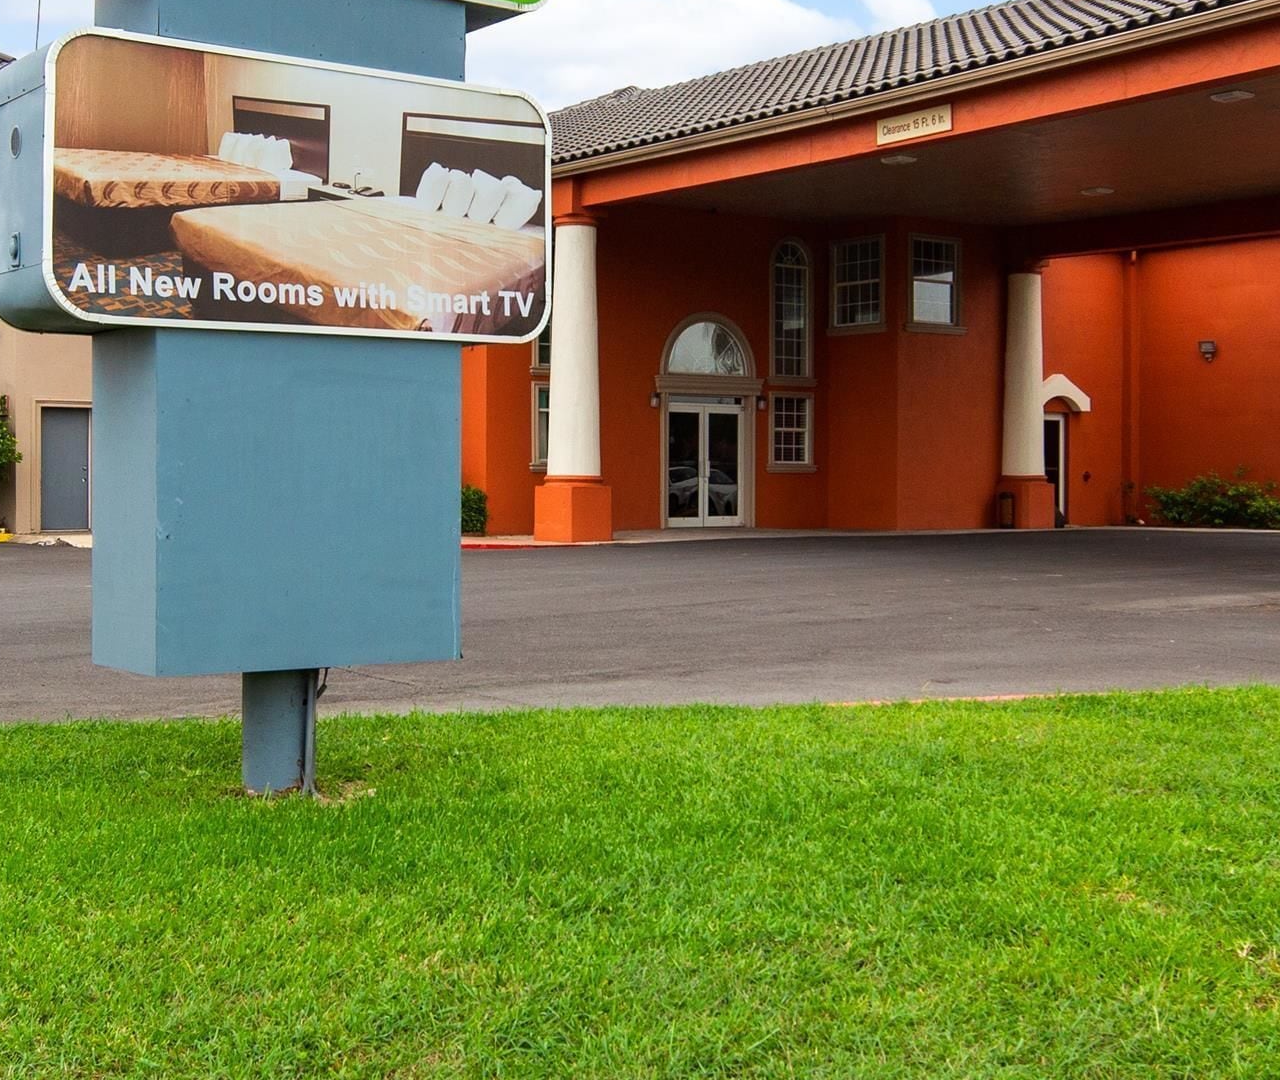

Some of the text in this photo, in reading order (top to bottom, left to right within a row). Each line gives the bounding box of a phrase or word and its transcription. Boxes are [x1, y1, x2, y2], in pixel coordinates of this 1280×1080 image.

[67, 262, 535, 318] All New Rooms with Smart TV
